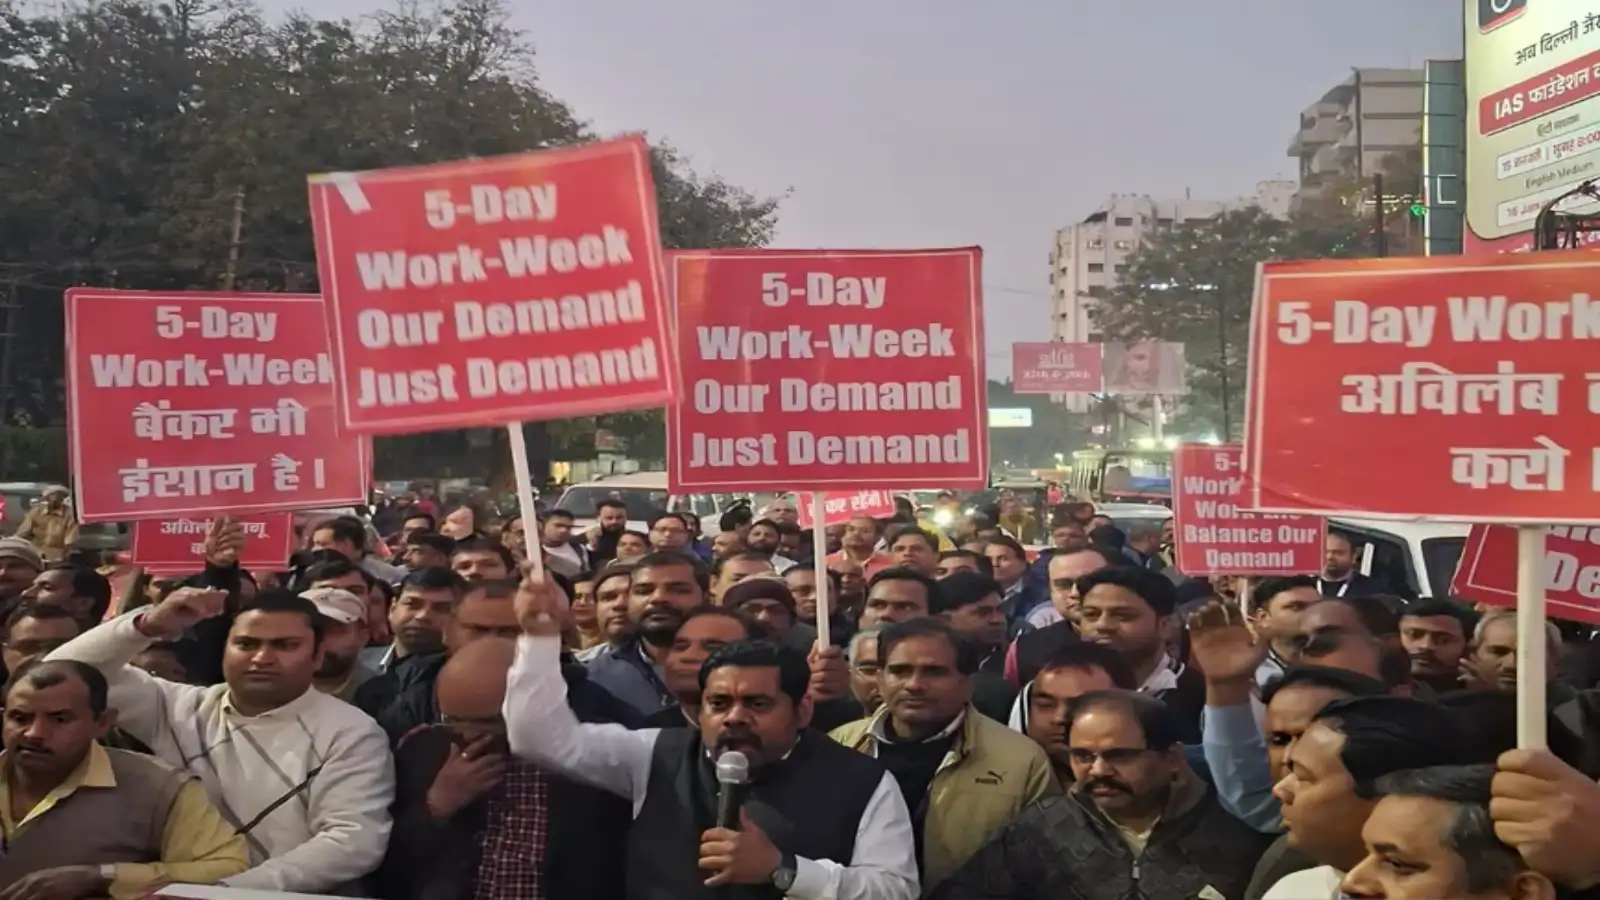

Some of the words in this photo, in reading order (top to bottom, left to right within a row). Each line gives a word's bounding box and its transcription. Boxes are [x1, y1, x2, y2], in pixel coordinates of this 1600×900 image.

[1514, 43, 1537, 66] अब
[1540, 20, 1579, 54] दिल्ली
[1495, 92, 1525, 120] IAS
[1528, 67, 1590, 103] फाउंडेशन
[1525, 171, 1557, 189] English
[1557, 161, 1594, 178] Medium
[424, 183, 557, 230] 5-Day
[356, 224, 633, 291] Work-Week
[762, 272, 886, 309] 5-Day
[156, 305, 277, 342] 5-Day
[358, 308, 444, 350] Our
[454, 280, 645, 342] Demand
[1277, 300, 1436, 348] 5-Day
[697, 323, 955, 361] Work-Week
[358, 364, 459, 409] Just
[466, 337, 659, 400] Demand
[694, 378, 769, 414] Our
[781, 375, 962, 412] Demand
[1340, 361, 1565, 416] अविलंब
[132, 400, 238, 440] बैंकर
[251, 398, 309, 436] भी
[690, 432, 778, 468] Just
[788, 428, 970, 466] Demand
[1449, 435, 1571, 491] करो
[118, 458, 256, 502] इंसान
[271, 453, 303, 491] है
[1184, 523, 1272, 544] Balance
[1279, 524, 1317, 543] Our
[1206, 549, 1295, 569] Demand
